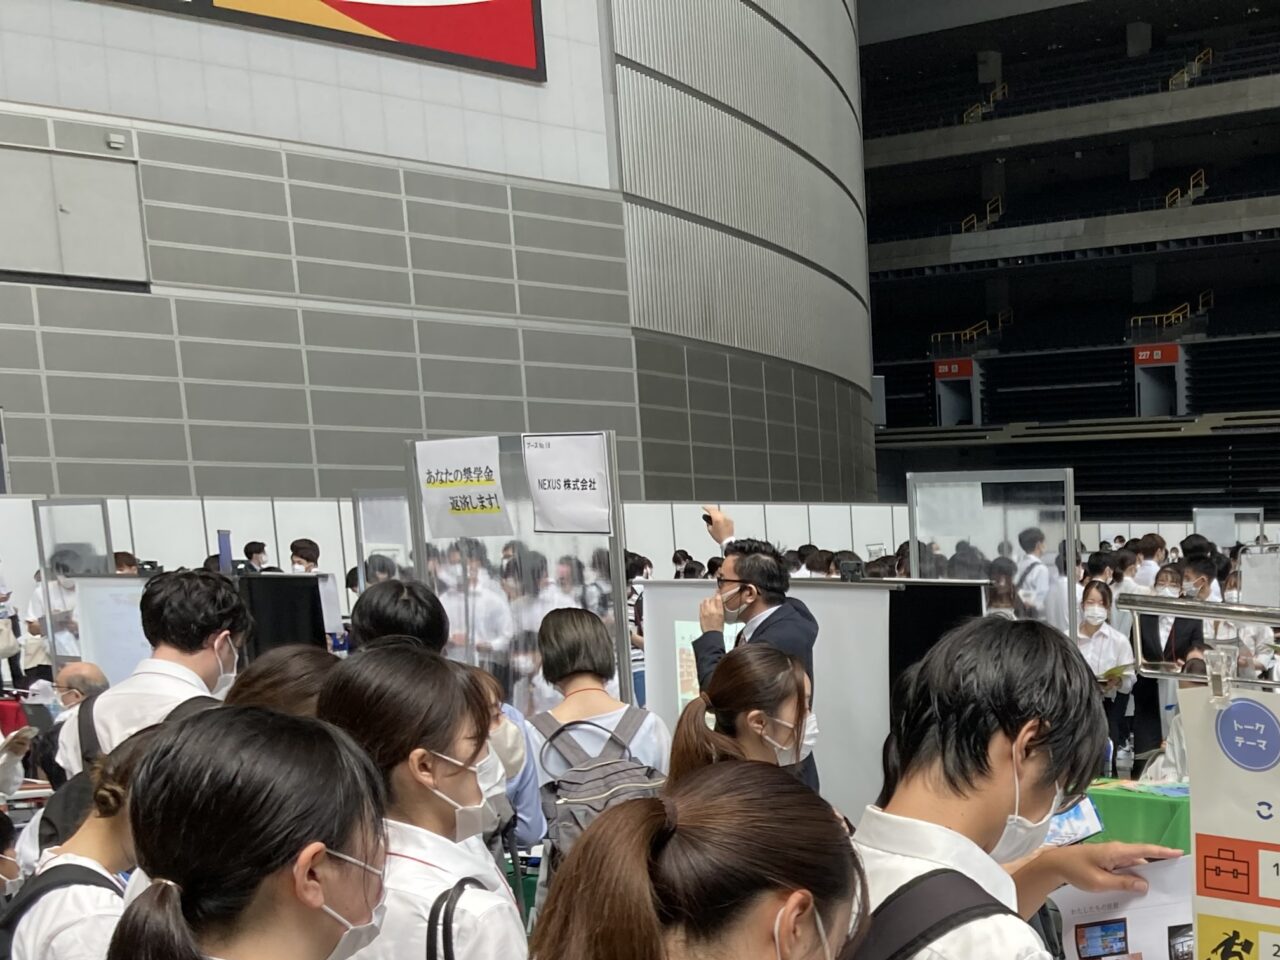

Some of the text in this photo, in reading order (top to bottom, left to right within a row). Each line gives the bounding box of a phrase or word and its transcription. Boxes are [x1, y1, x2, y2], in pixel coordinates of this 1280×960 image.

[537, 478, 597, 491] NEXUS 株式会社
[1233, 719, 1266, 735] トーク
[1234, 736, 1267, 751] テーマ
